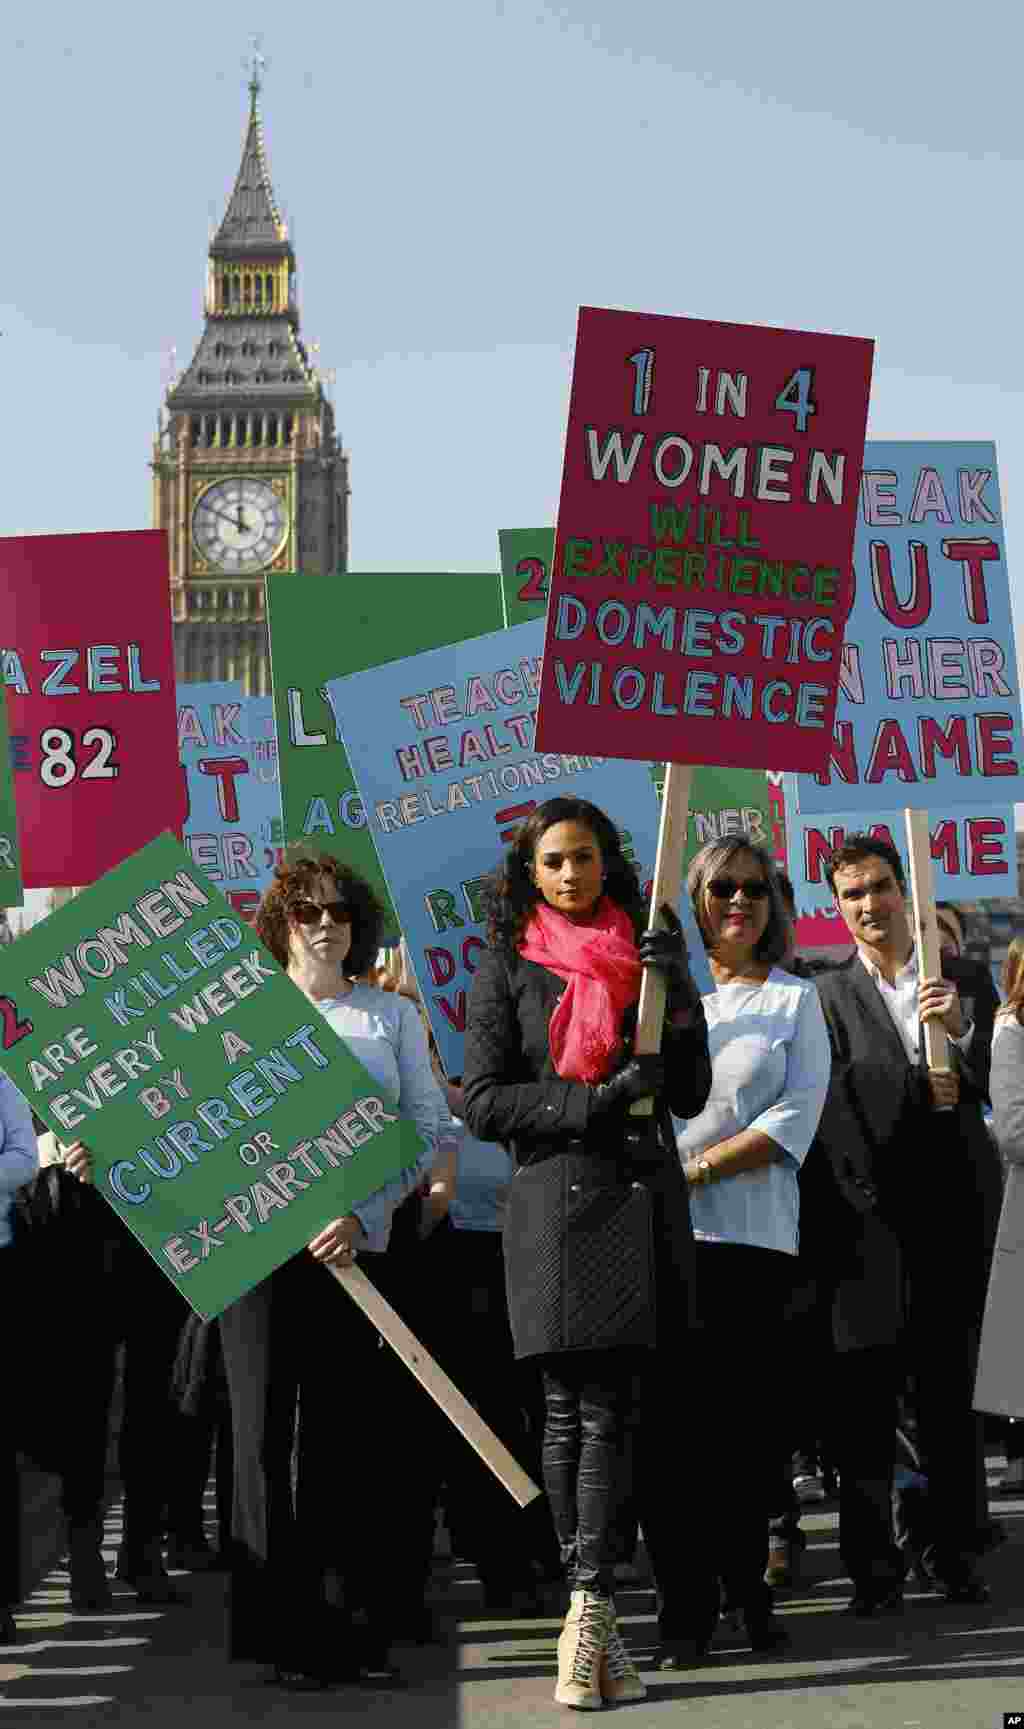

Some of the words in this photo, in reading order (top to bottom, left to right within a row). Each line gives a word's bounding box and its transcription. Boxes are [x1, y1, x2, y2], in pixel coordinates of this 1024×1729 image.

[629, 347, 655, 416] 1
[695, 366, 748, 418] IN
[775, 366, 816, 431] 4
[586, 425, 847, 505] WOMEN
[862, 467, 1000, 527] EAK
[650, 503, 761, 550] WILL
[513, 556, 549, 602] 2
[563, 537, 841, 604] EXPERIENCE
[847, 537, 1000, 629] UT
[555, 592, 836, 665] DOMESTIC
[553, 657, 828, 728] VIOLENCE
[882, 636, 1012, 700] HER
[40, 727, 121, 789] 82
[395, 712, 539, 782] HEALT
[814, 713, 1018, 786] NAME
[0, 995, 34, 1050] 2
[26, 870, 210, 1008] WOMEN
[27, 1026, 98, 1091] ARE
[103, 917, 244, 1026] KILLED
[47, 1028, 164, 1130] EVERY
[168, 950, 279, 1033] WEEK
[137, 1065, 192, 1120] BY
[221, 1030, 254, 1064] A
[107, 1024, 330, 1205] CURRENT
[238, 1131, 281, 1168] OR
[162, 1095, 400, 1275] EX-PARTNER
